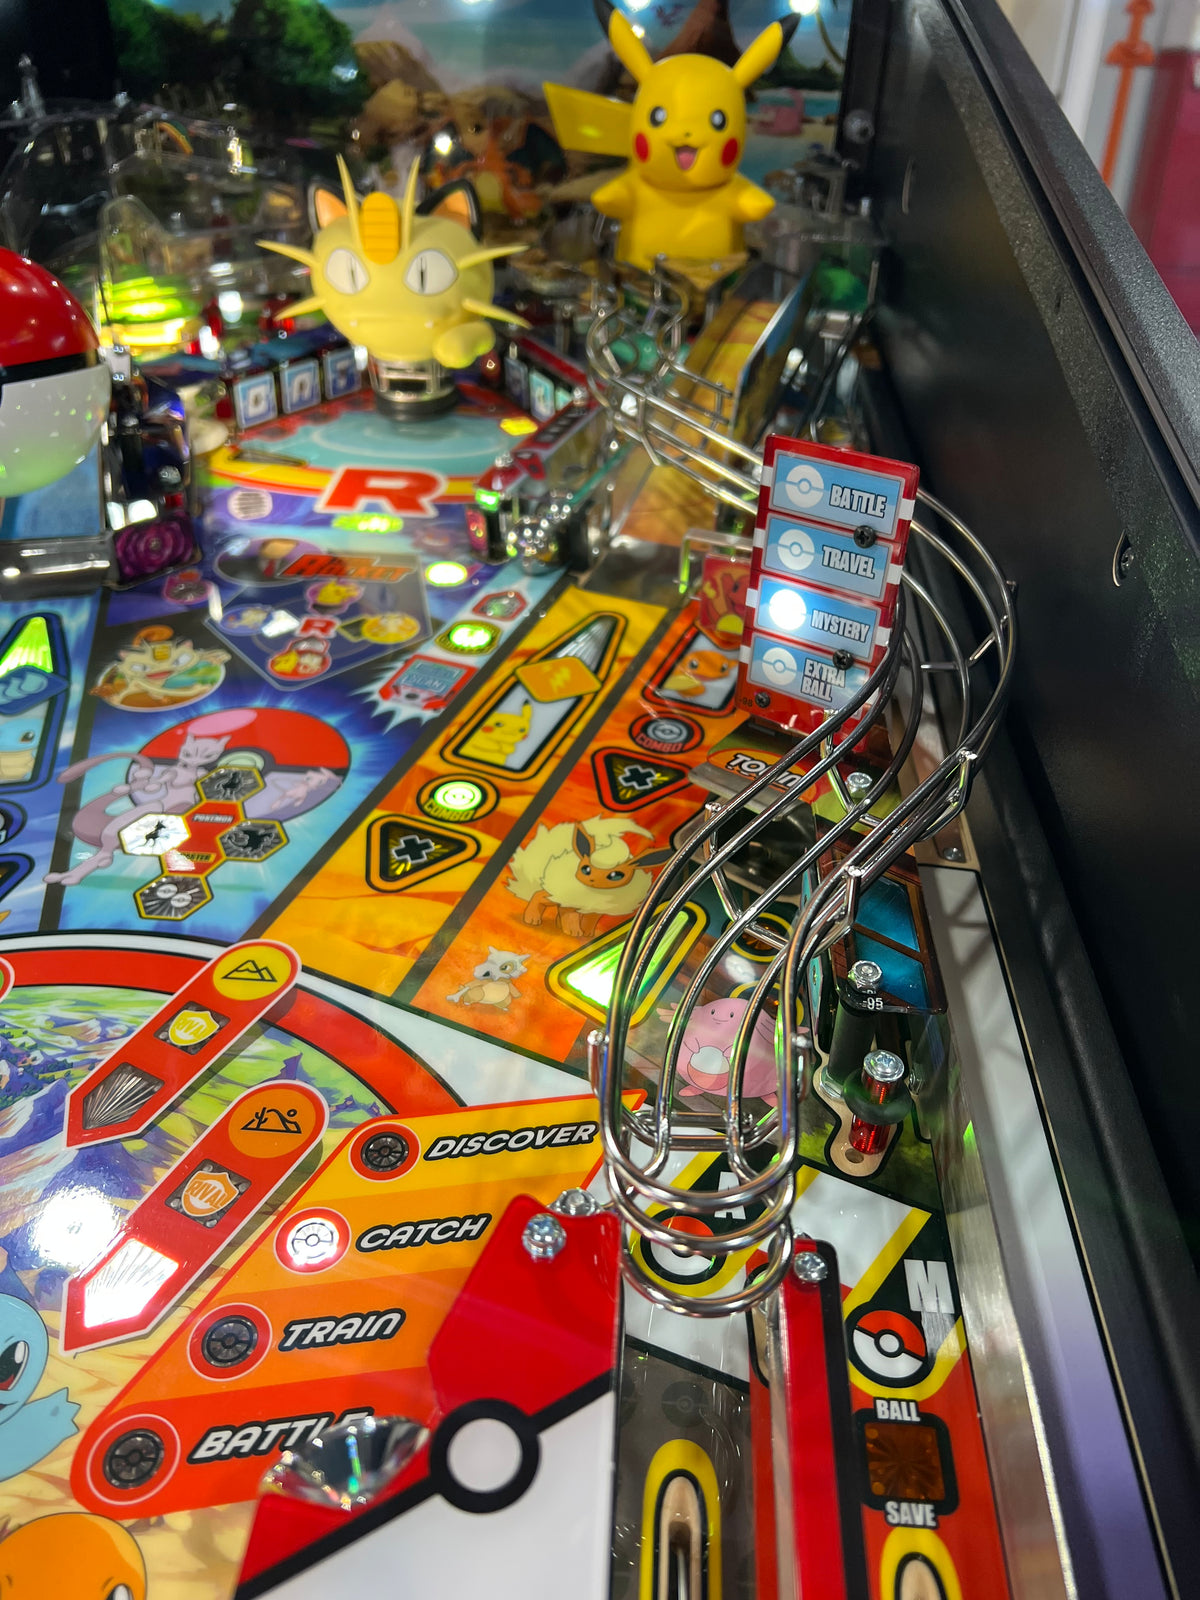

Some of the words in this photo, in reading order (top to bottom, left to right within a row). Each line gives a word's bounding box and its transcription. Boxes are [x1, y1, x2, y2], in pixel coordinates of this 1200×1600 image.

[322, 467, 442, 515] R
[829, 484, 887, 518] BATTLE
[822, 545, 875, 579] TRAVEL
[811, 609, 870, 643] MYSTERY
[801, 675, 833, 702] BALL
[804, 657, 847, 689] EXTRA
[635, 733, 684, 753] COMBO
[423, 798, 475, 822] COMBO
[427, 1123, 597, 1159] DISCOVER
[185, 1179, 228, 1210] RIVAL
[359, 1216, 488, 1249] CATCH
[903, 1258, 955, 1314] M
[283, 1312, 402, 1347] TRAIN
[875, 1399, 921, 1422] BALL
[885, 1500, 937, 1527] SAVE
